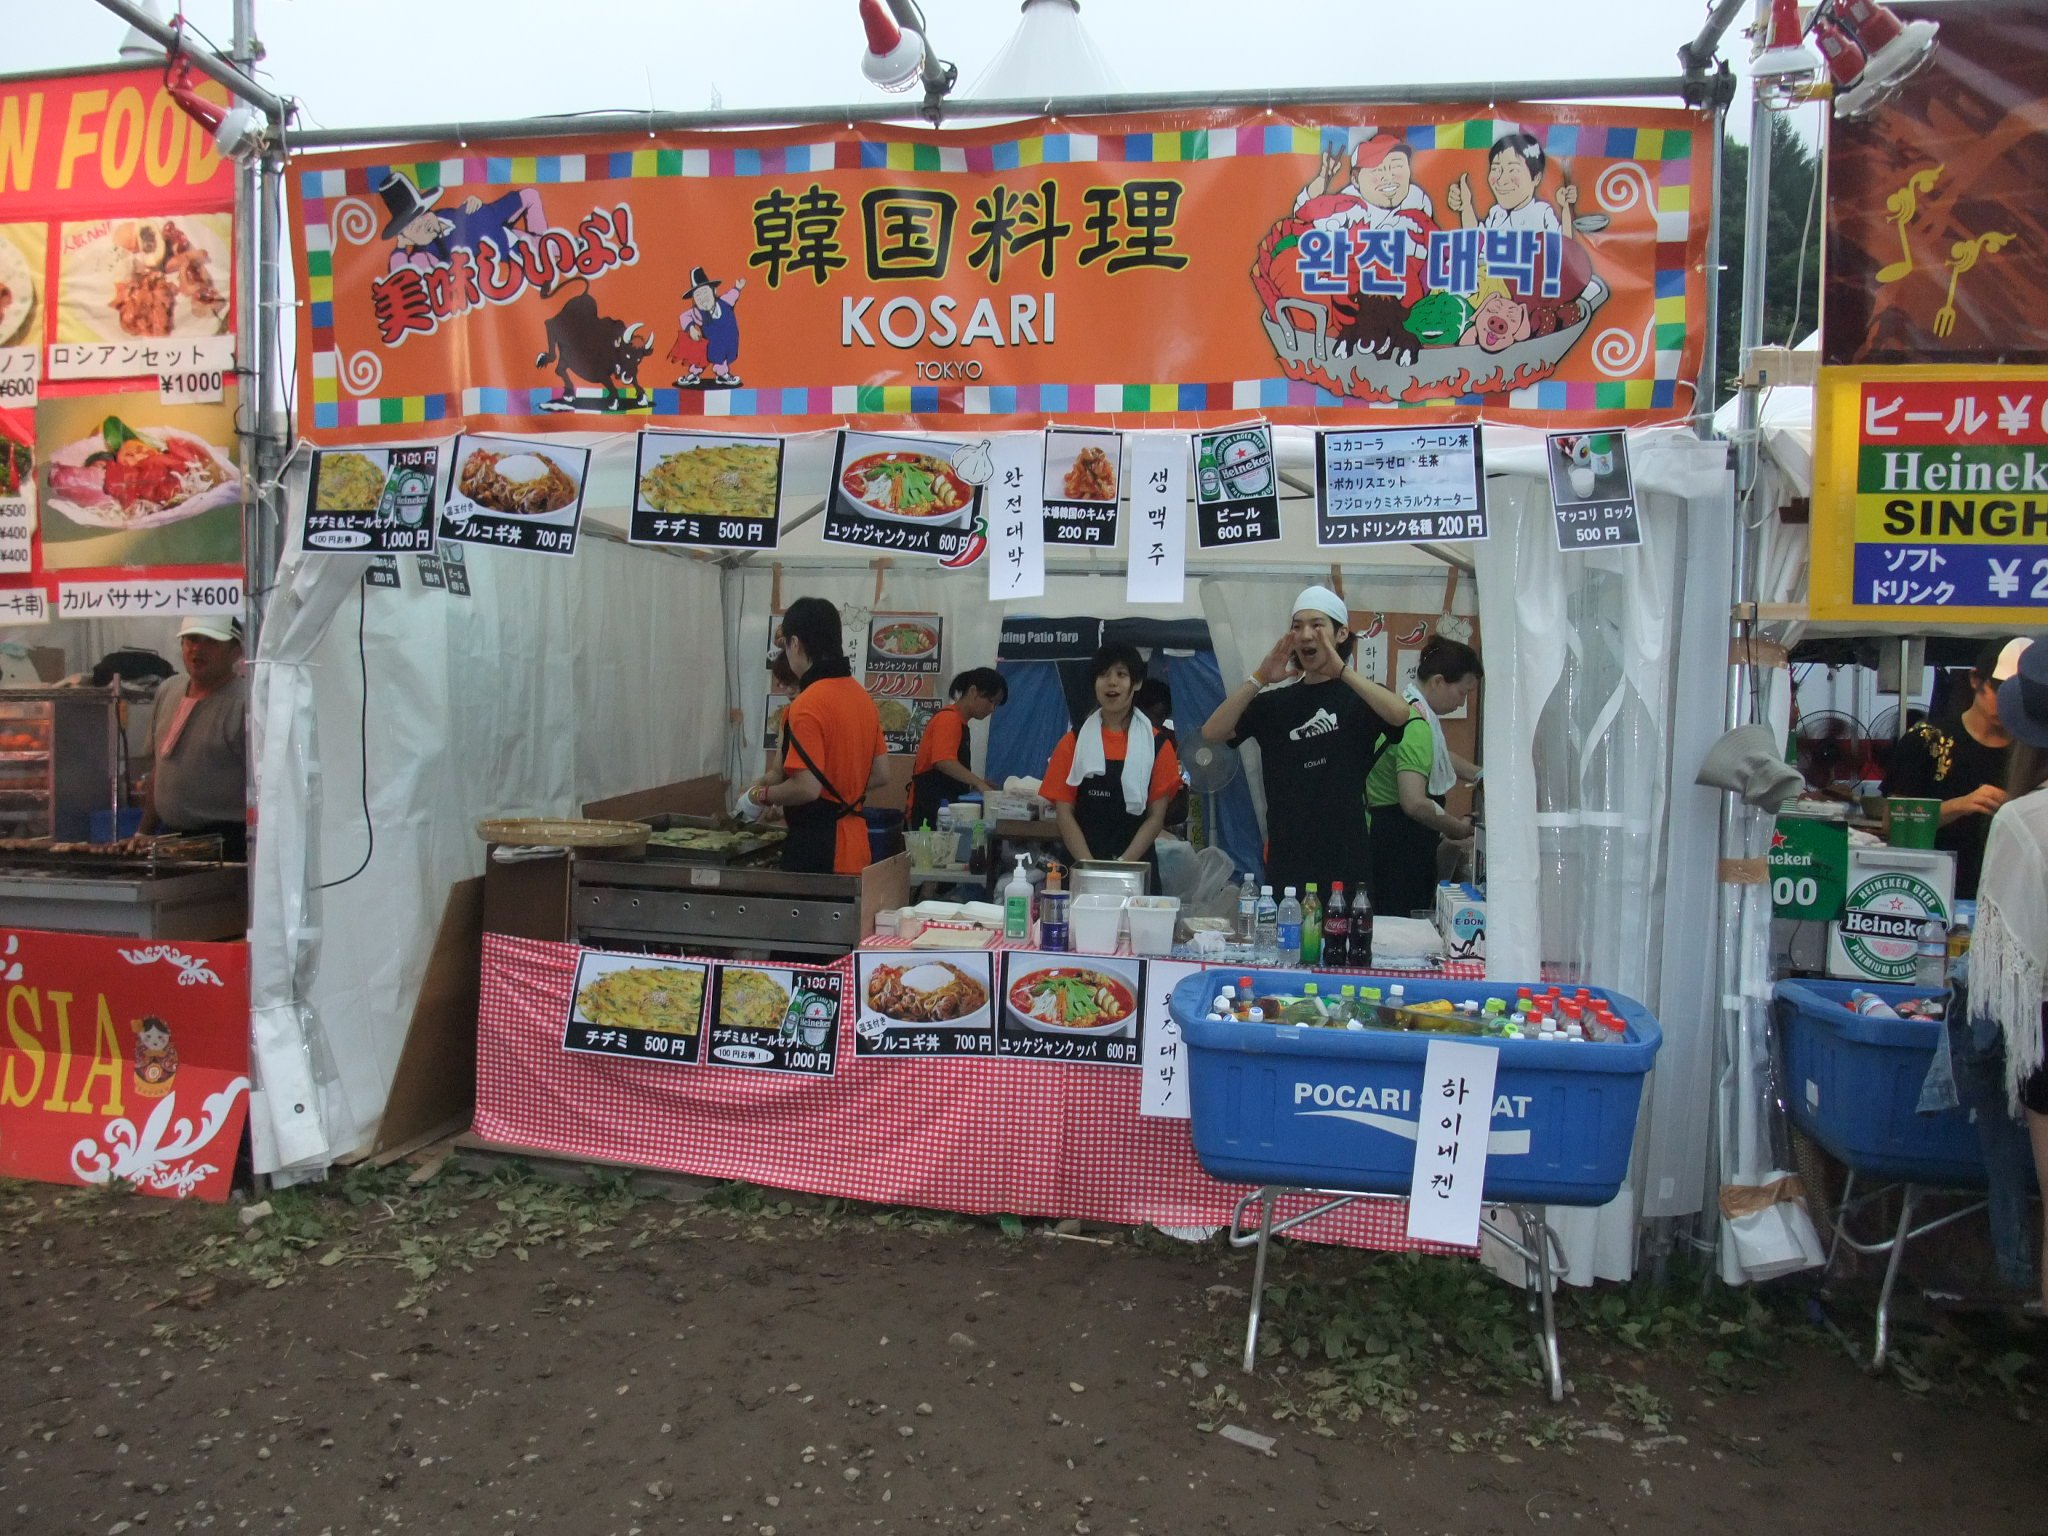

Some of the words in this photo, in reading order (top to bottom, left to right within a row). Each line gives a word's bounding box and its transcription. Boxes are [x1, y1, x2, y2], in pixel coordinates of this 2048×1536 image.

[56, 79, 230, 189] FOOD
[748, 178, 1190, 290] 韓国料理
[1297, 228, 1408, 296] 완전
[1426, 227, 1564, 298] 대박!
[841, 293, 1056, 348] KOSARI
[54, 345, 205, 368] ロシアンセット
[161, 371, 222, 393] ¥1000
[915, 361, 983, 381] TOKYO
[653, 518, 700, 537] チヂミ
[1147, 468, 1169, 567] 생맥주
[1216, 508, 1260, 523] ビール
[828, 522, 930, 548] ユッケジャンクッパ
[1325, 518, 1433, 540] ソフトドリンク各種
[1884, 548, 1947, 573] ソフト
[1872, 579, 1955, 605] ドリンク
[1028, 631, 1053, 643] Patio
[1056, 631, 1078, 643] Tarp
[1858, 878, 1910, 900] HEINEKEN
[1912, 884, 1937, 908] BEER
[1850, 943, 1890, 974] PREMIUM
[586, 1029, 628, 1049] チヂミ
[1000, 1036, 1098, 1058] ユッケジャンクッパ
[1293, 1081, 1410, 1112] POCARI
[1430, 1076, 1470, 1199] 하이네켄
